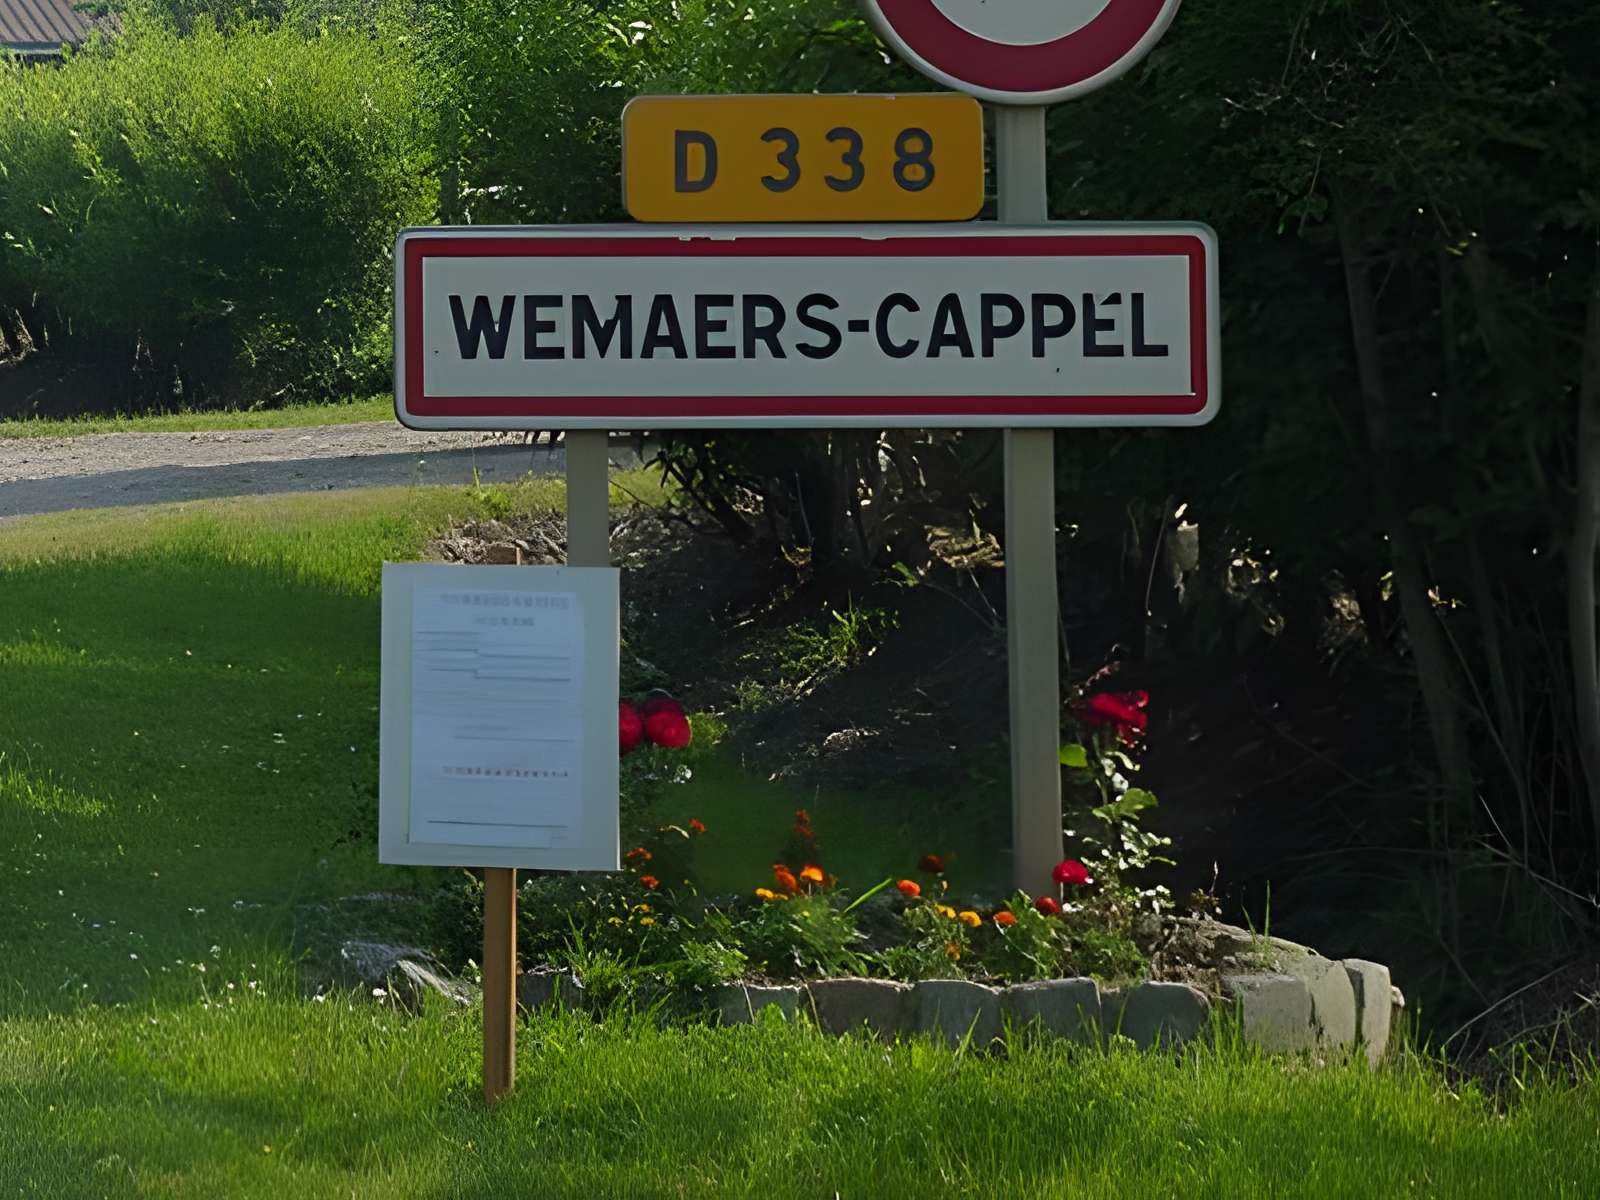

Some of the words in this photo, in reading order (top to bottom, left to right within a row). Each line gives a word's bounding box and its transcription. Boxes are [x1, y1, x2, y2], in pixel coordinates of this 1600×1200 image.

[675, 129, 718, 193] D
[760, 126, 935, 193] 338
[448, 292, 1169, 360] WEMAERS-CAPPEL
